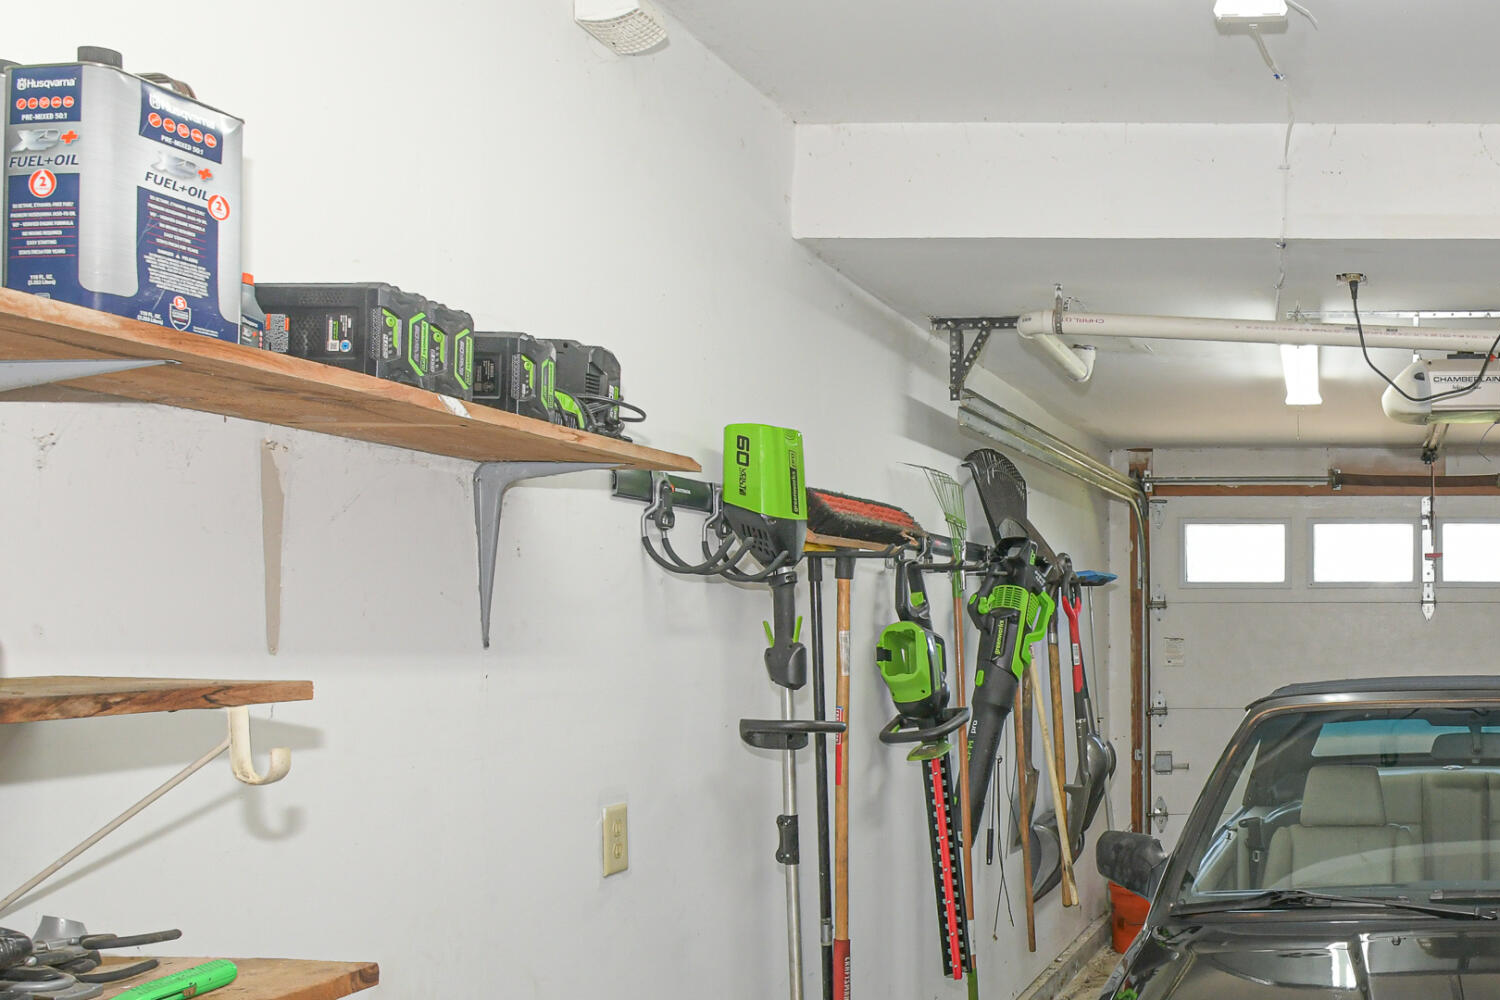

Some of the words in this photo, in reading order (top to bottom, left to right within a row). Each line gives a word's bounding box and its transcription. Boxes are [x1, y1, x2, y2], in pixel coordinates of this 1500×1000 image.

[27, 78, 76, 89] Husqvarna
[21, 113, 54, 121] PRE-MIXED
[9, 154, 80, 168] FUEL+OIL
[39, 177, 47, 187] 2
[145, 171, 209, 202] FUEL+OIL
[215, 201, 223, 211] 2
[736, 434, 750, 467] 60
[970, 719, 978, 734] pro
